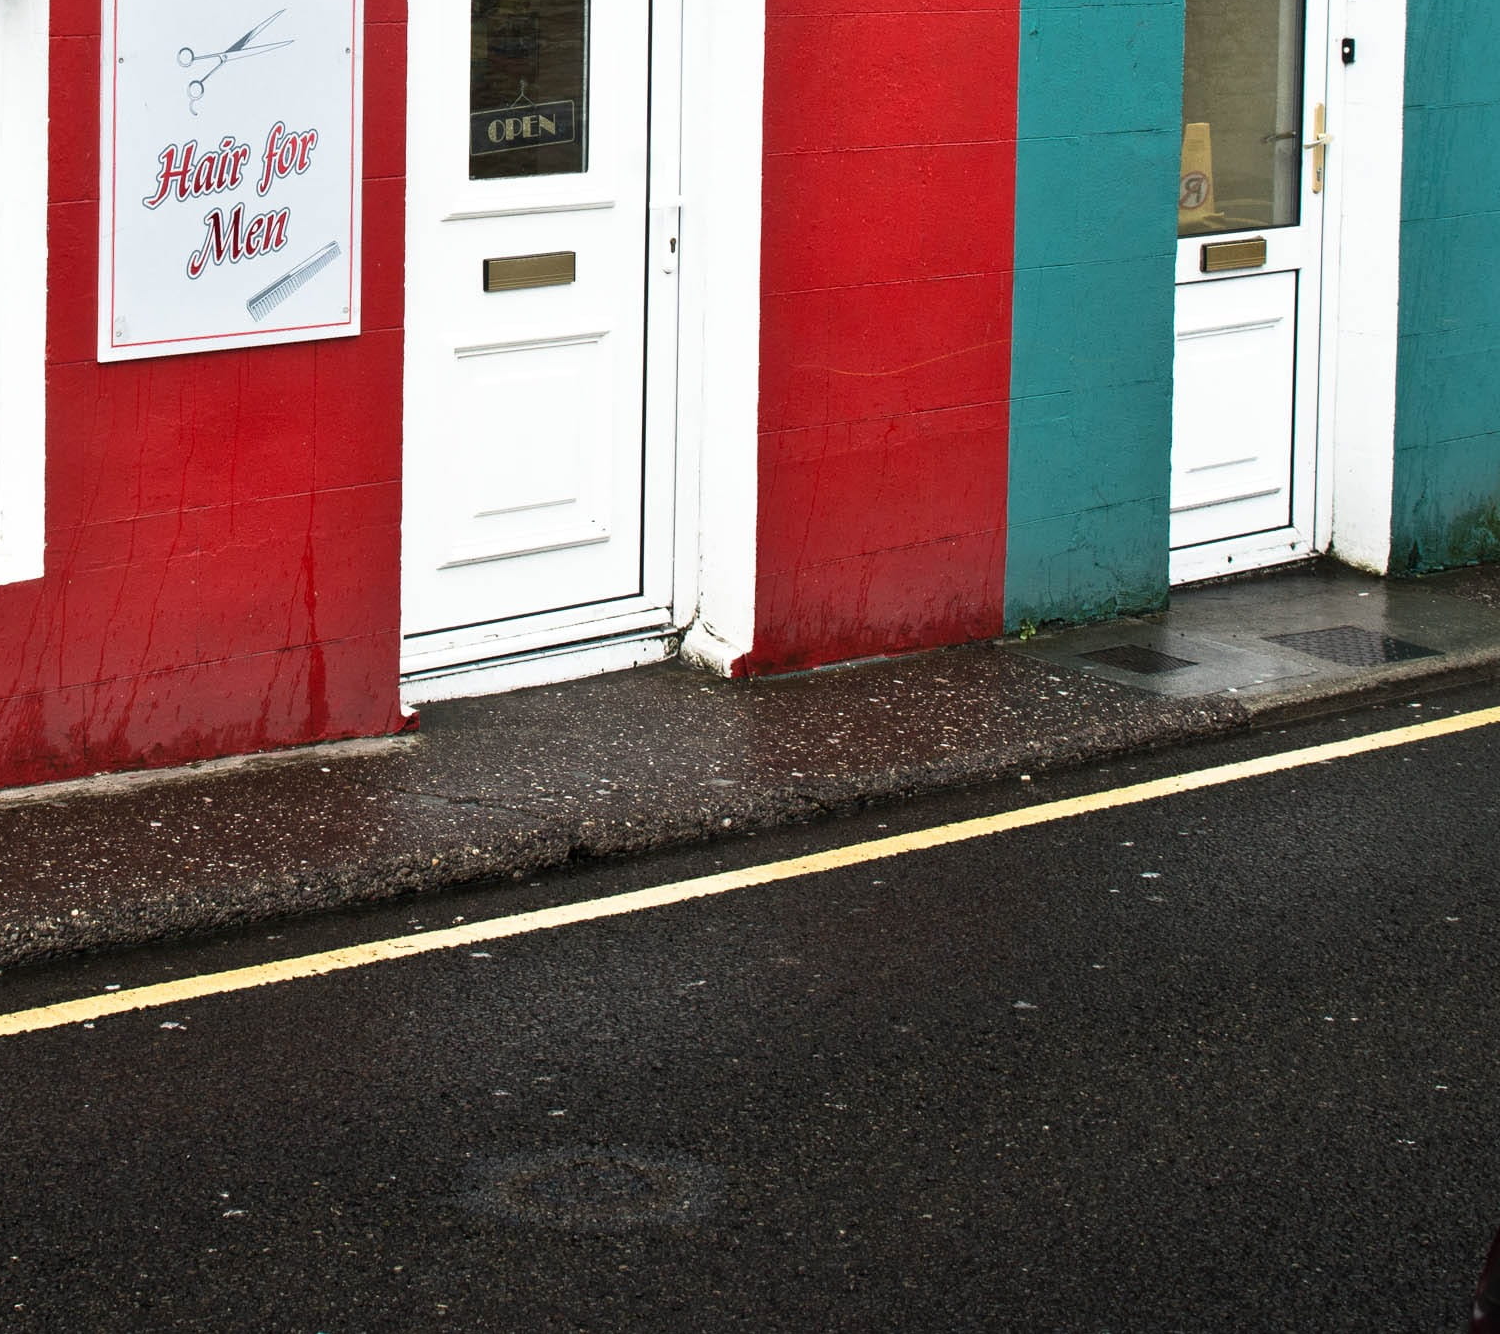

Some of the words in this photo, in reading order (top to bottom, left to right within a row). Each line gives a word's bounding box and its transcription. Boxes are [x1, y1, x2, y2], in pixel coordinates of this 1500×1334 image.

[144, 137, 249, 210] Hair
[258, 121, 318, 199] for
[487, 113, 557, 143] OPEN
[186, 205, 291, 280] Men
